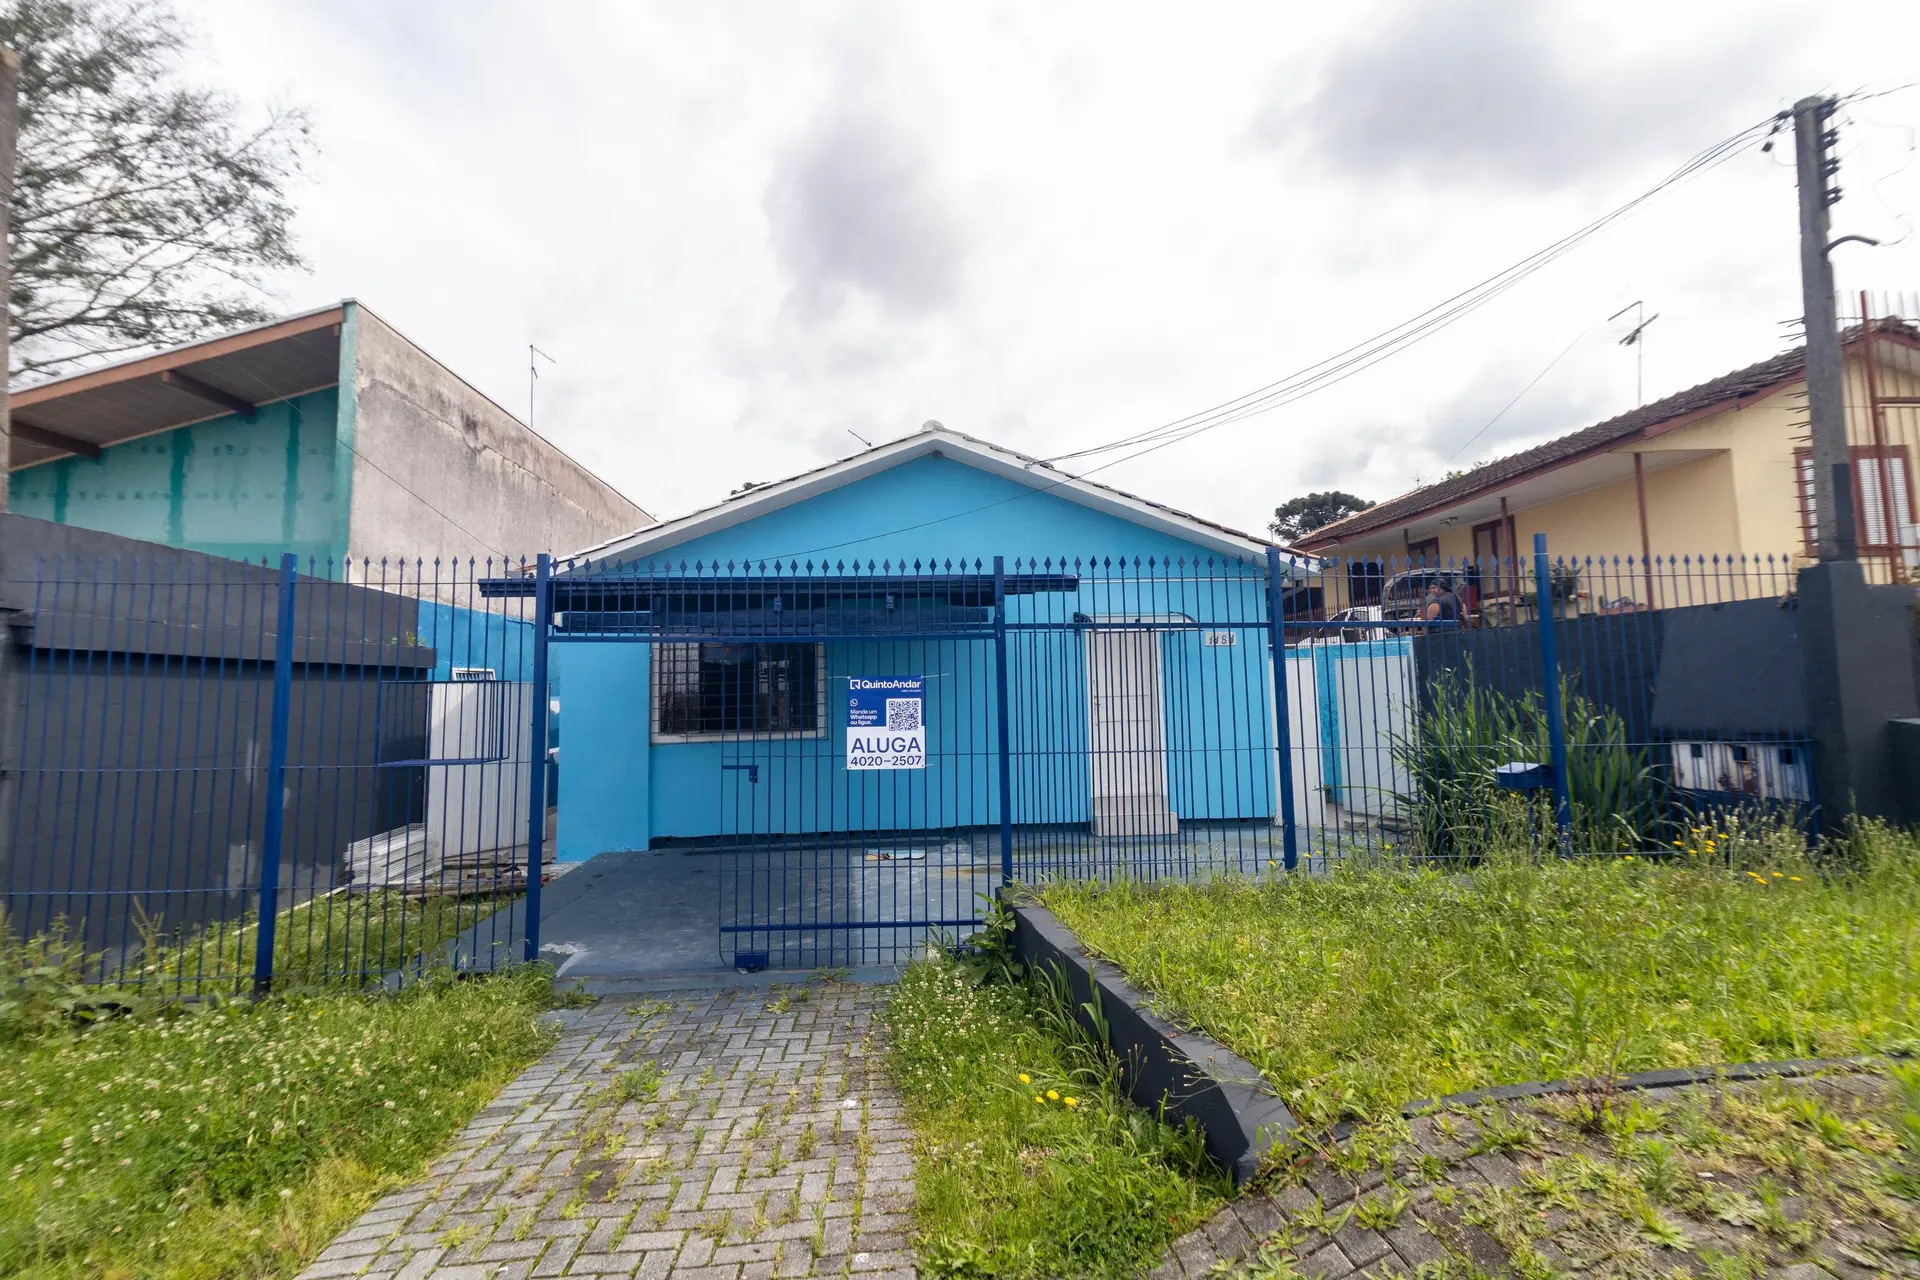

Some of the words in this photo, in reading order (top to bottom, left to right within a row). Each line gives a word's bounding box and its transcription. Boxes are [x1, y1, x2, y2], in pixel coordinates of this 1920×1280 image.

[862, 680, 921, 689] QuintoAndar
[851, 737, 921, 753] ALUGA
[850, 756, 922, 766] 4020-2507
